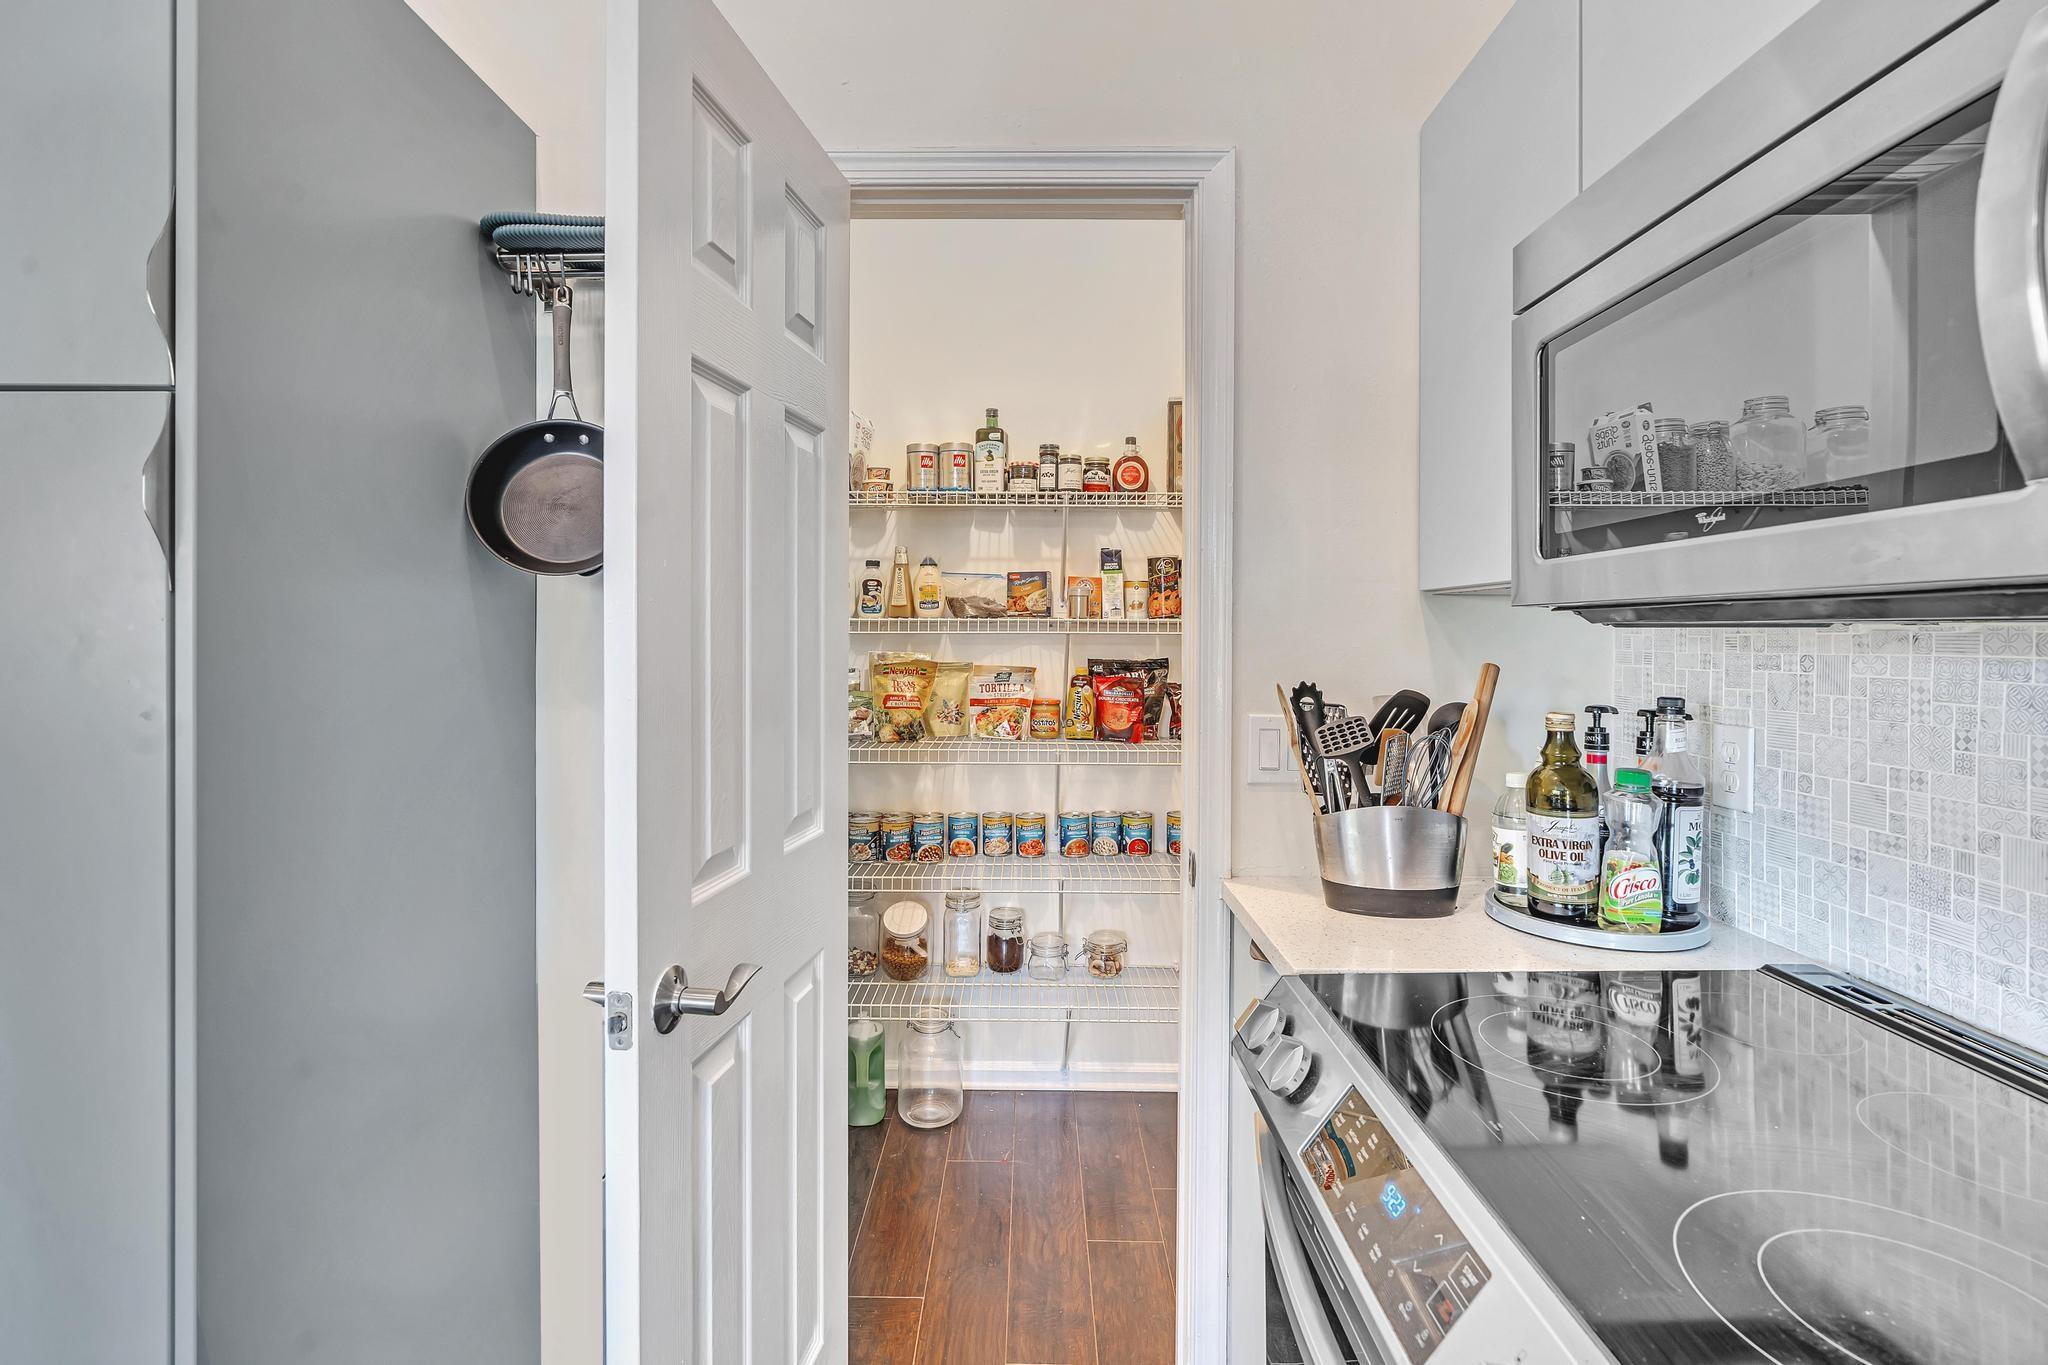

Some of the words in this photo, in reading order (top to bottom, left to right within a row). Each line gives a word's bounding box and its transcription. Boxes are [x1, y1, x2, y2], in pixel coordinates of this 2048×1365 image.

[921, 457, 933, 467] illy
[954, 455, 966, 467] illy
[979, 683, 1025, 693] TORTILLA
[1531, 835, 1559, 849] EXTRA
[1561, 840, 1594, 850] VIRGIN
[1539, 849, 1567, 861] OLIVE
[1570, 852, 1587, 862] OIL
[1614, 878, 1657, 899] Crisco
